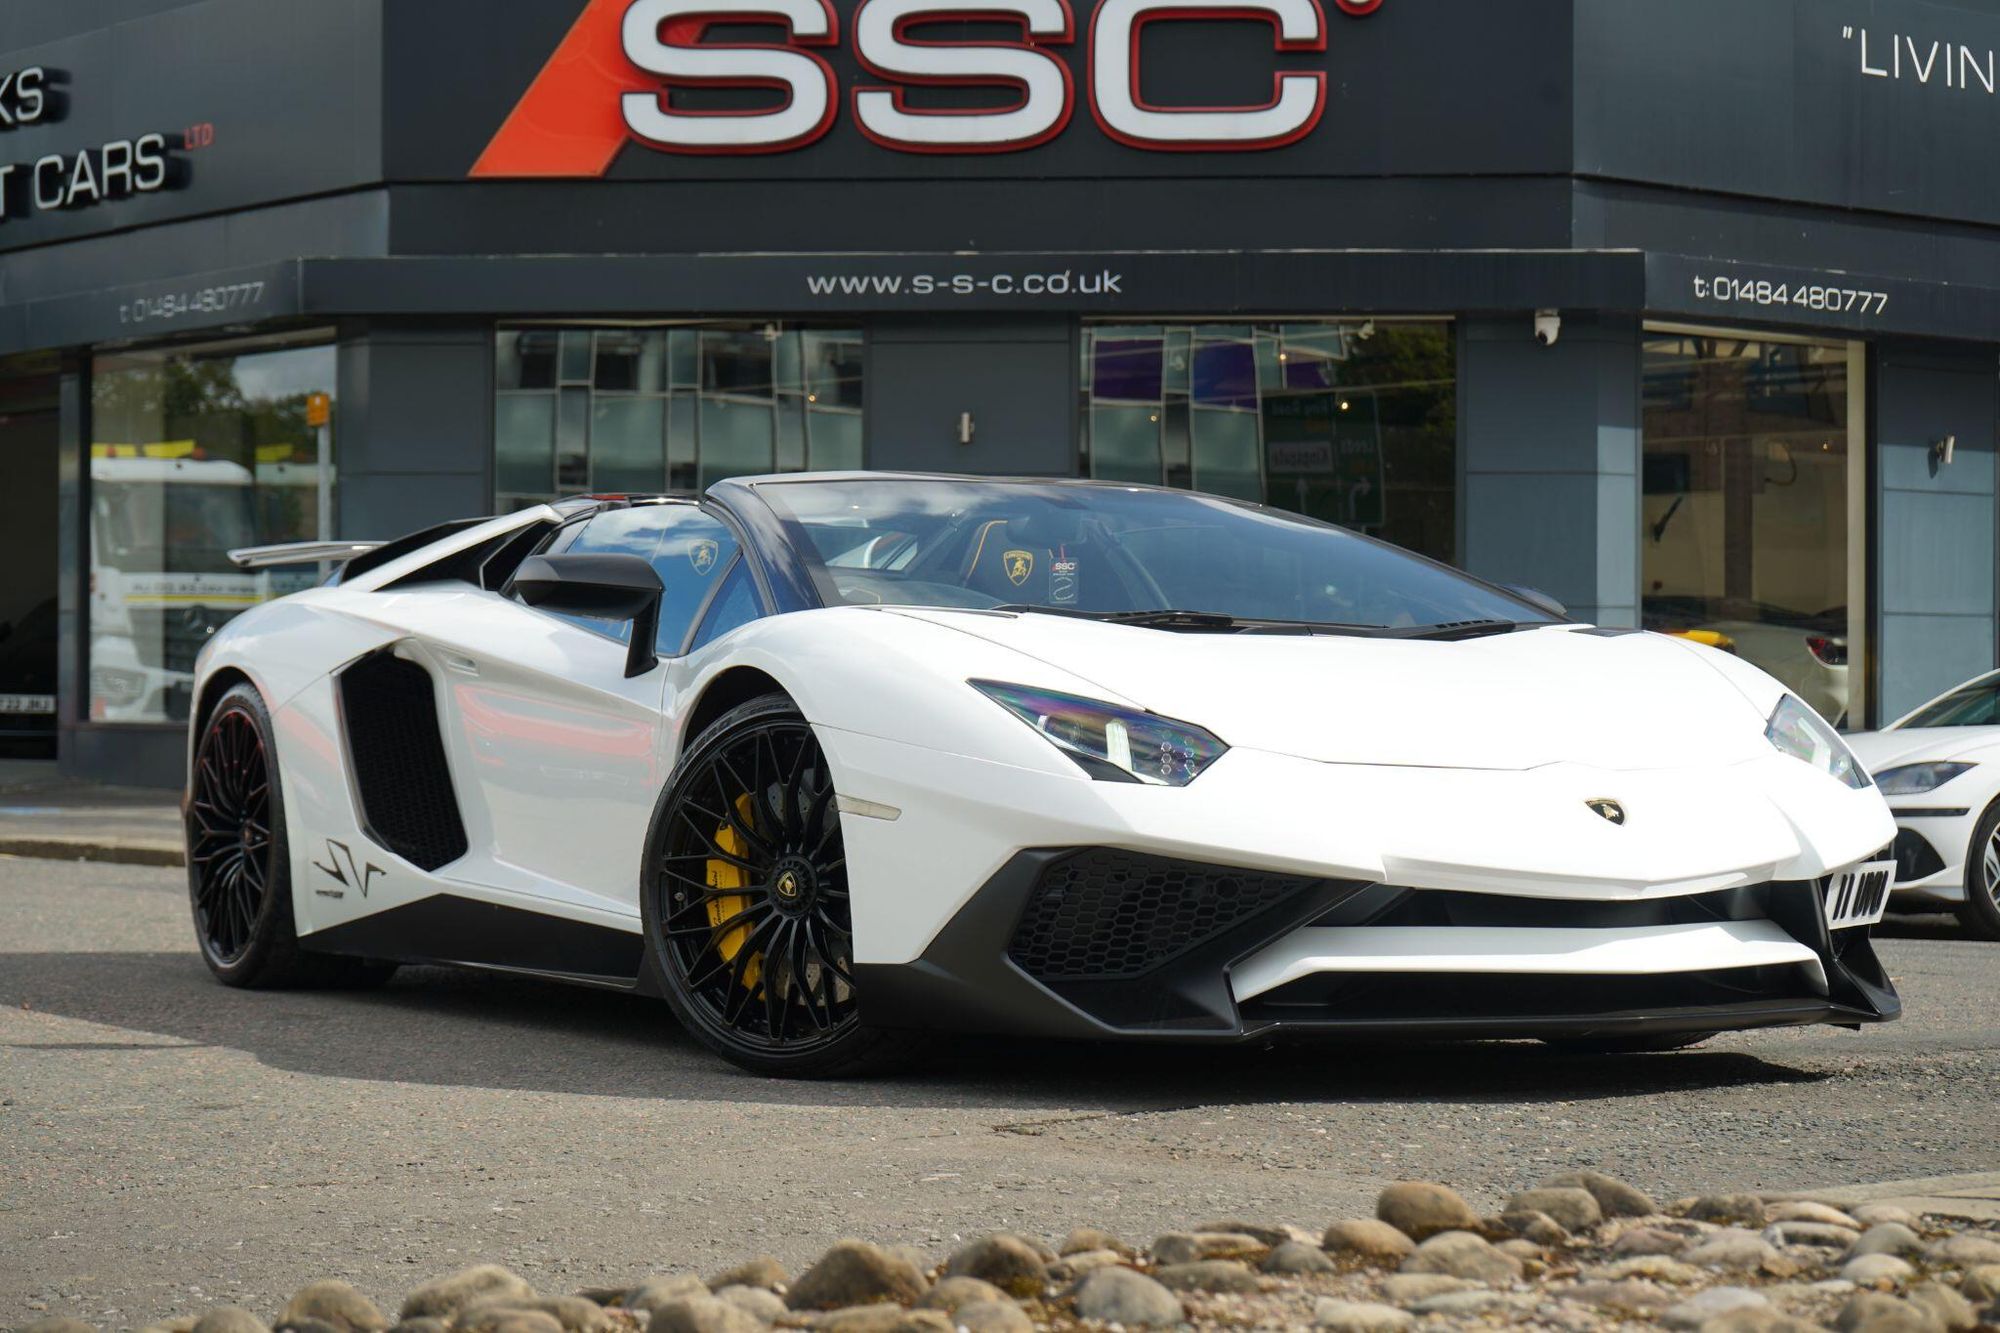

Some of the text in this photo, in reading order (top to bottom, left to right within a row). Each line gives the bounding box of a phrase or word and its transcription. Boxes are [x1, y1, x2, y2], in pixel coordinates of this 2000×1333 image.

[621, 0, 1327, 153] SSC
[34, 133, 165, 210] CARS
[184, 122, 214, 150] LTD
[806, 270, 1122, 295] www.s-s-c.co.uk
[1055, 562, 1075, 570] SSC
